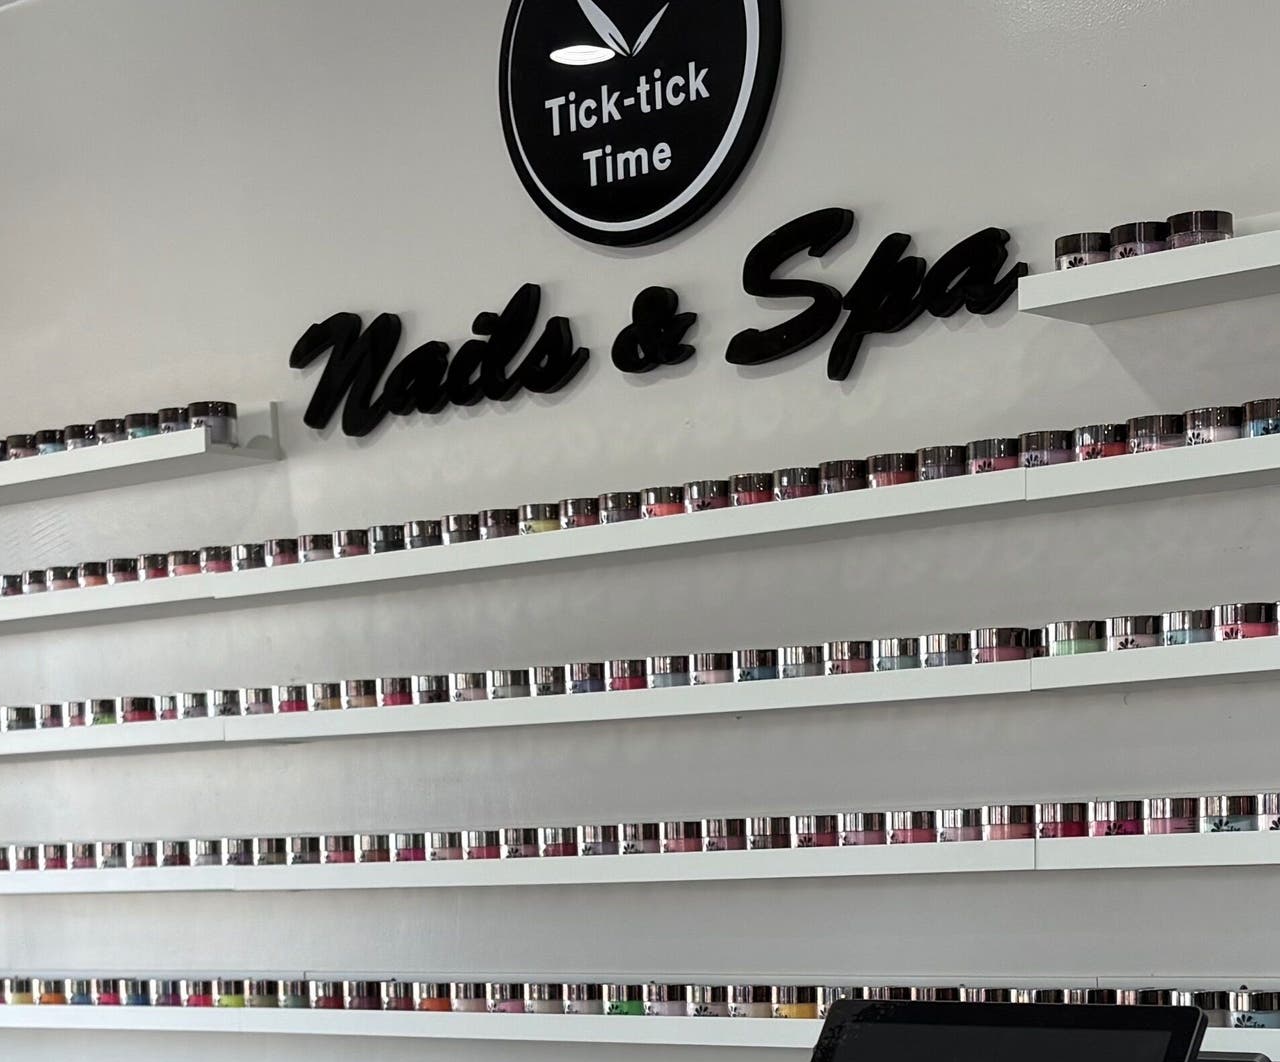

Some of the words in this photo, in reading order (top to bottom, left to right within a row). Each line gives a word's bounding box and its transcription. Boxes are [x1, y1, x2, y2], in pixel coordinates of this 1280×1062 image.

[545, 62, 710, 138] Tick-tick
[583, 138, 672, 188] Time
[289, 283, 590, 437] Nails
[612, 286, 697, 375] &
[725, 207, 1029, 381] Spa
